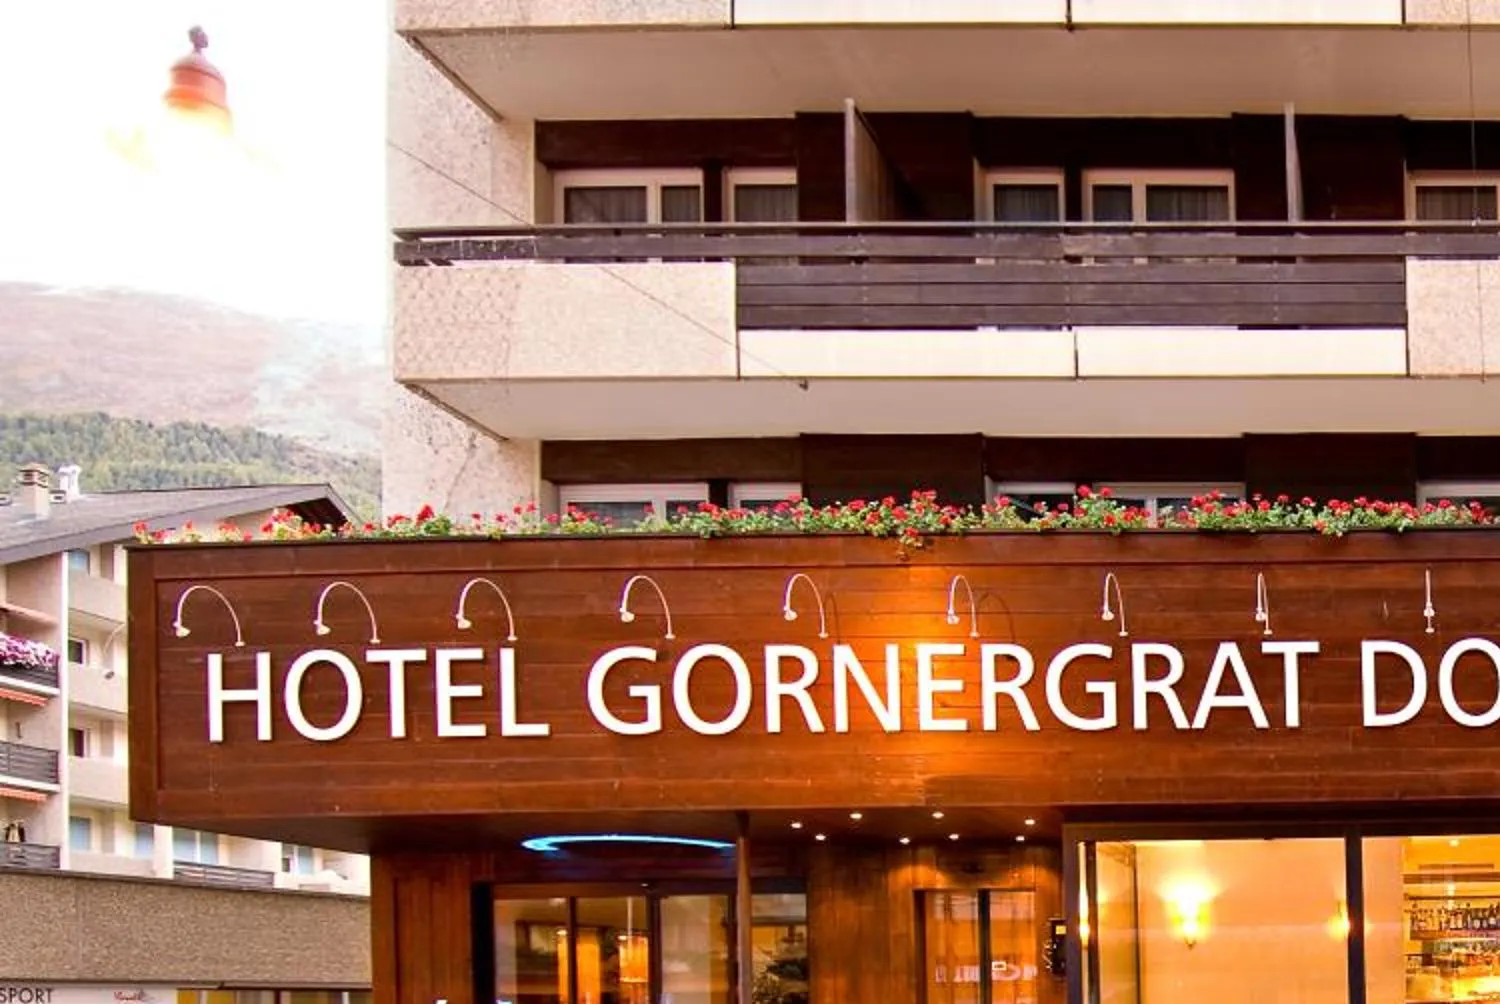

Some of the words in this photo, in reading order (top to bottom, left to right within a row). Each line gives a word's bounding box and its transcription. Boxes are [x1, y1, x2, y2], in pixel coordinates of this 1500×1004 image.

[207, 647, 550, 742] HOTEL
[586, 641, 1321, 737] GORNERGRAT
[0, 987, 53, 1004] SPORT
